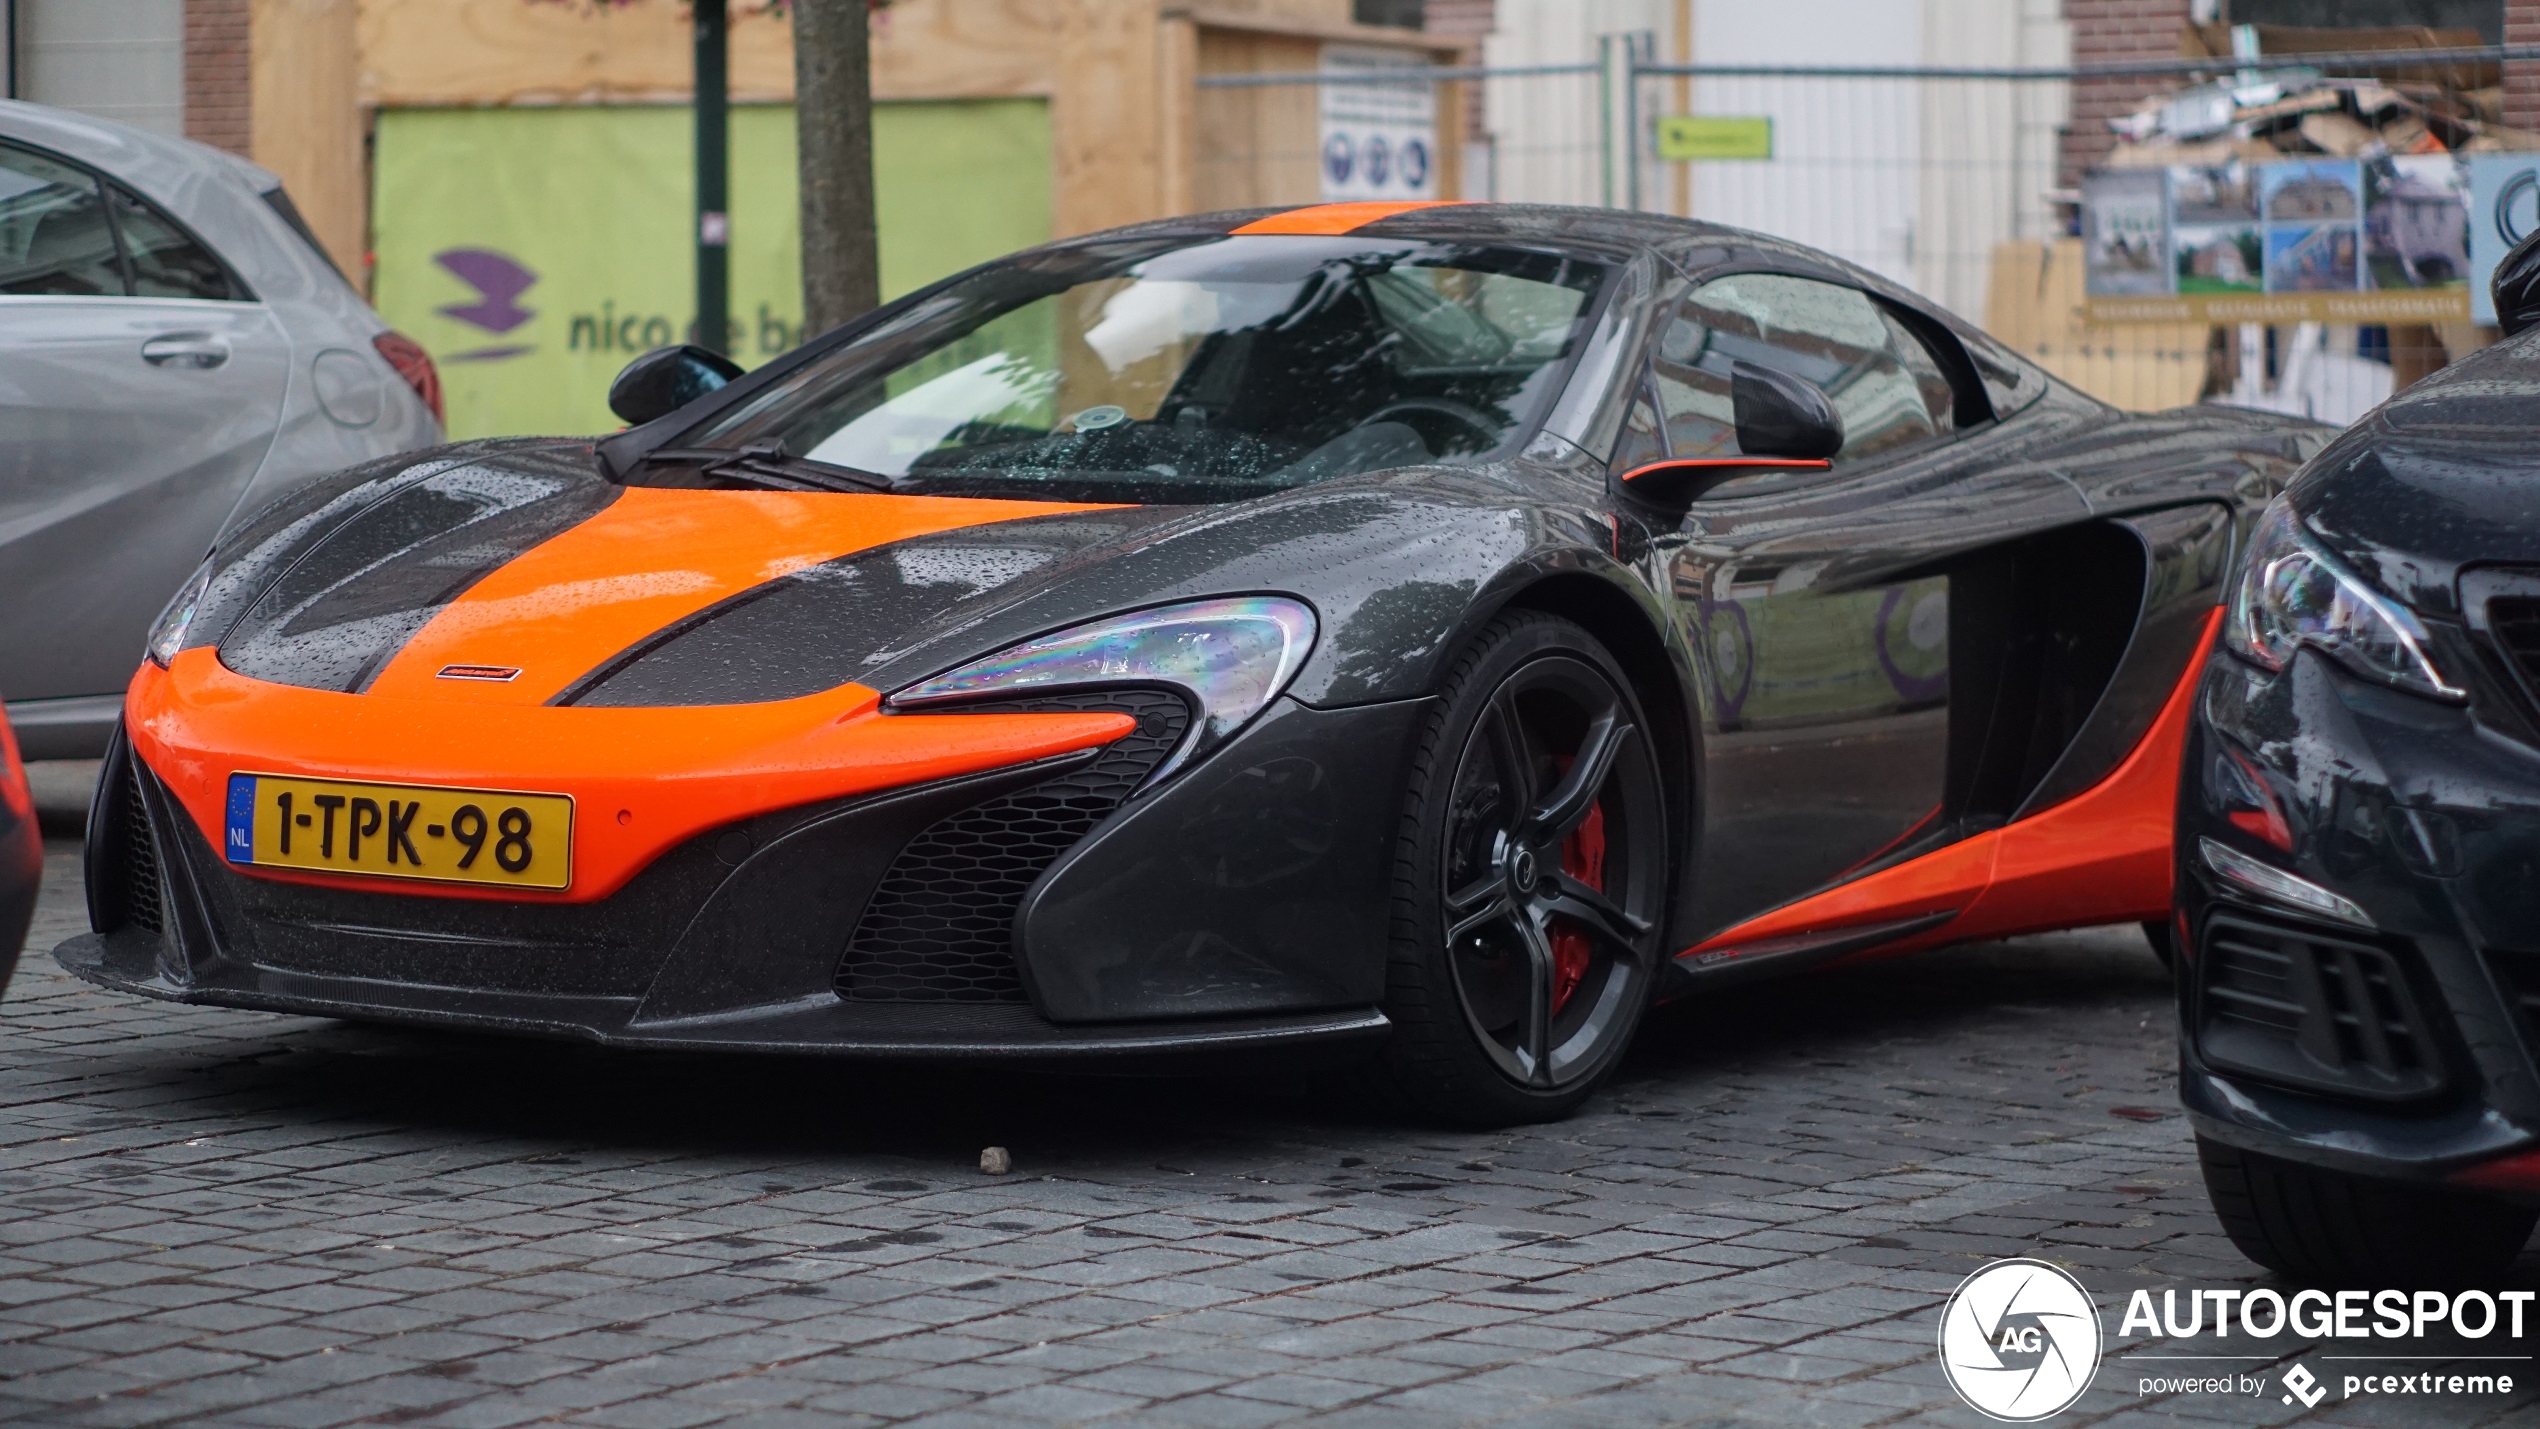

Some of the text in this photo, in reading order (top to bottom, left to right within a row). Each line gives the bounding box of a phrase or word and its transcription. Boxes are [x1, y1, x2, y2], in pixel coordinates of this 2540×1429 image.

[569, 300, 672, 352] nico
[231, 827, 250, 848] NL
[277, 791, 533, 872] 1-TPK-98
